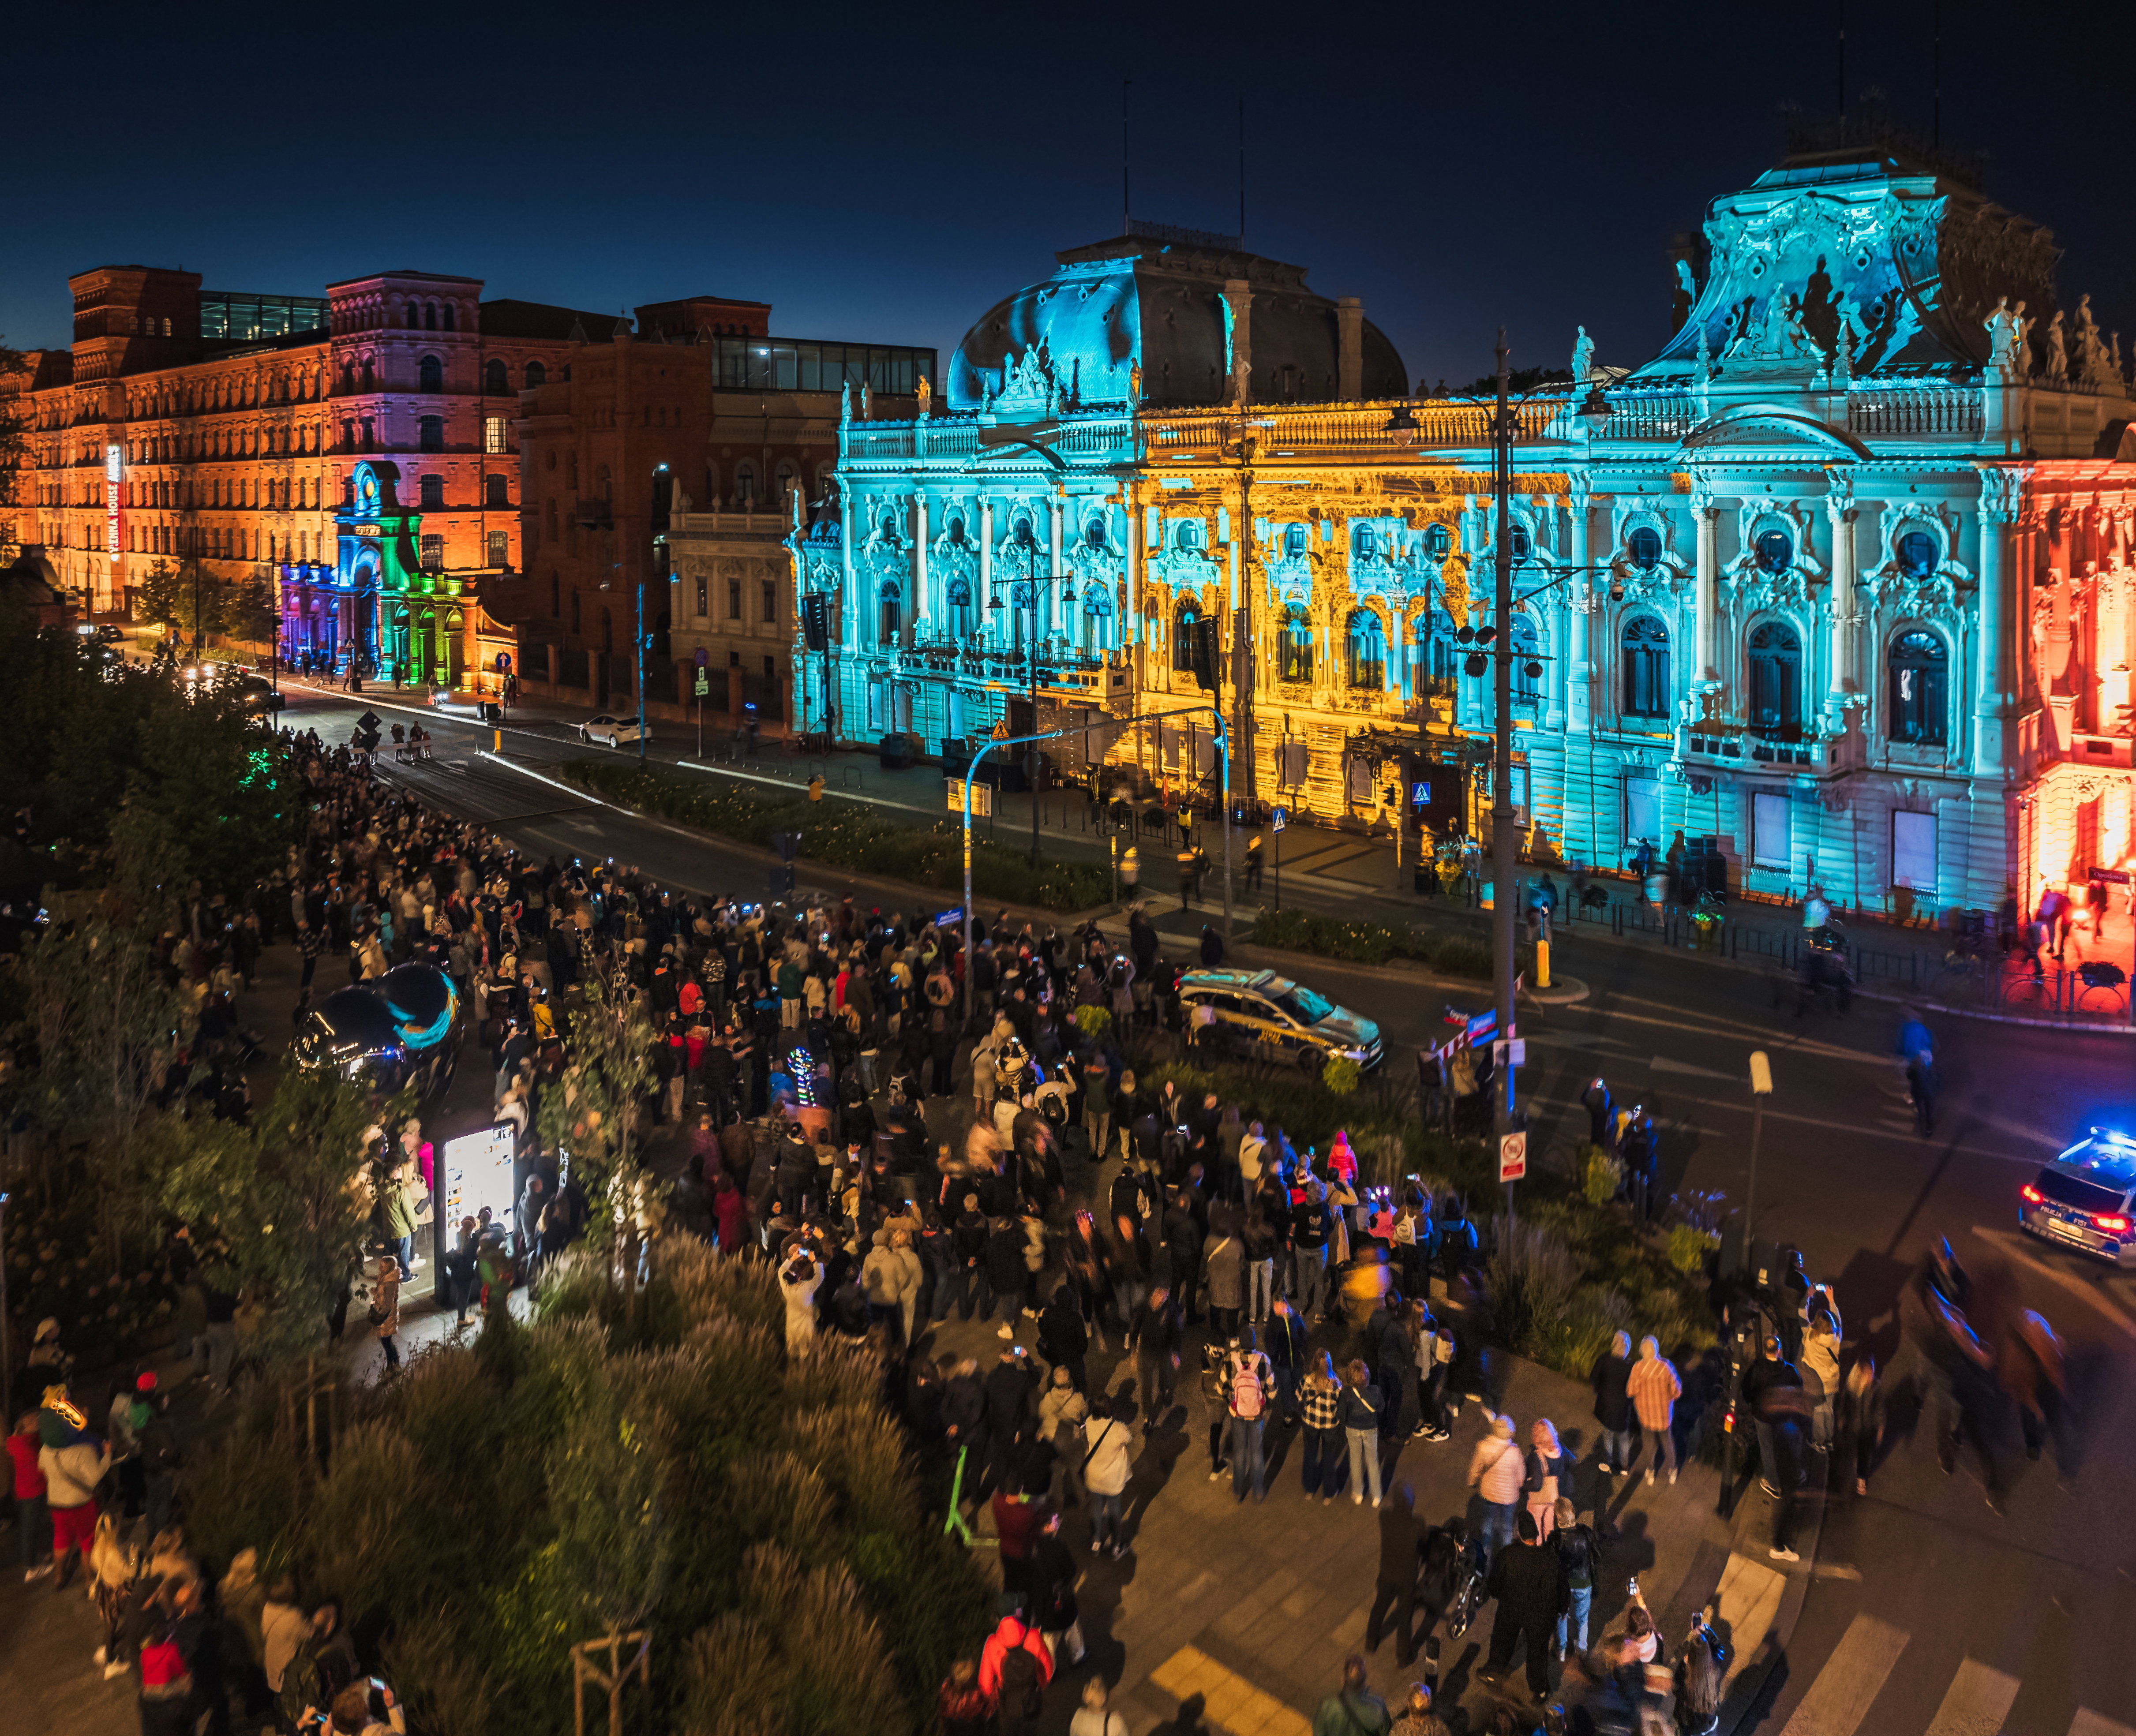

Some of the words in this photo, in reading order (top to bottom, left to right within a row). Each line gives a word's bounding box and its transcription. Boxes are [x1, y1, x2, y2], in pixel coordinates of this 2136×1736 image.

[108, 485, 118, 515] HOUSE
[2094, 872, 2123, 880] Ogrodowa
[2040, 1206, 2061, 1218] POLICJA
[2074, 1218, 2087, 1227] F151
